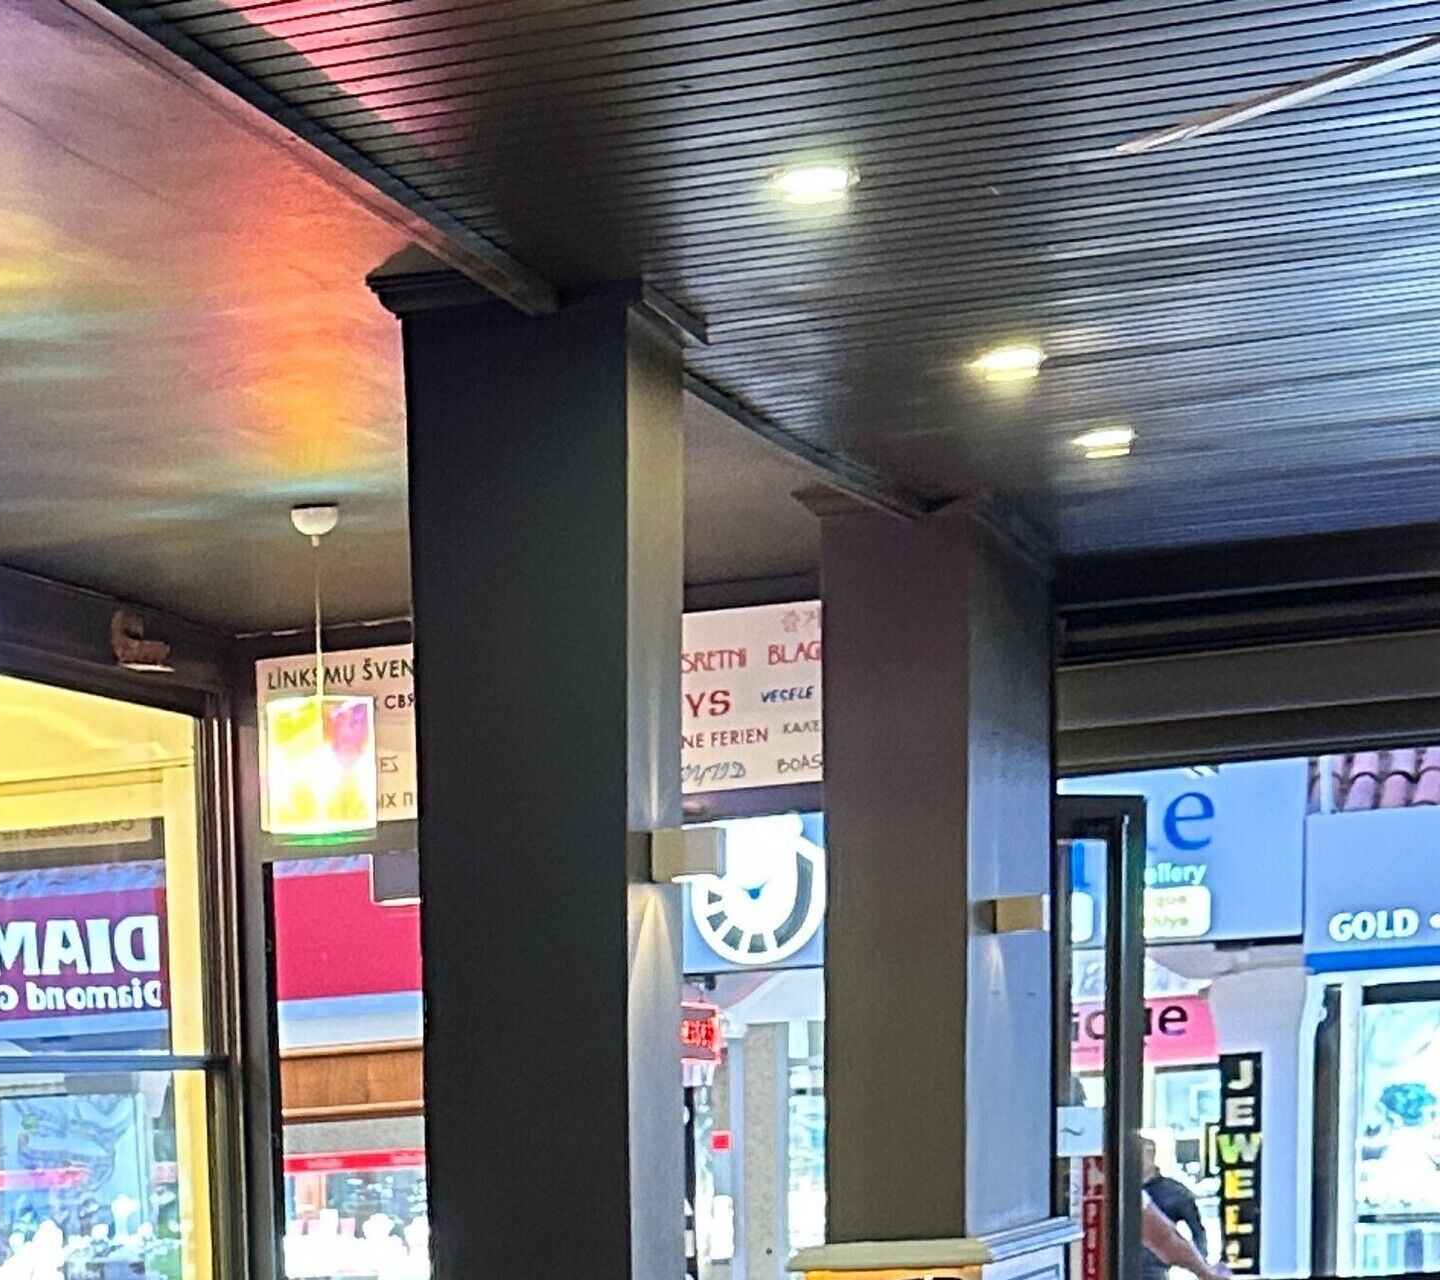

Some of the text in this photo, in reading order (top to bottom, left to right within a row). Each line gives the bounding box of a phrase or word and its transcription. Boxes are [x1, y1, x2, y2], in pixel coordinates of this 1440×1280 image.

[685, 689, 732, 718] YS
[710, 727, 769, 748] FERIEN
[1328, 907, 1420, 942] GOLD
